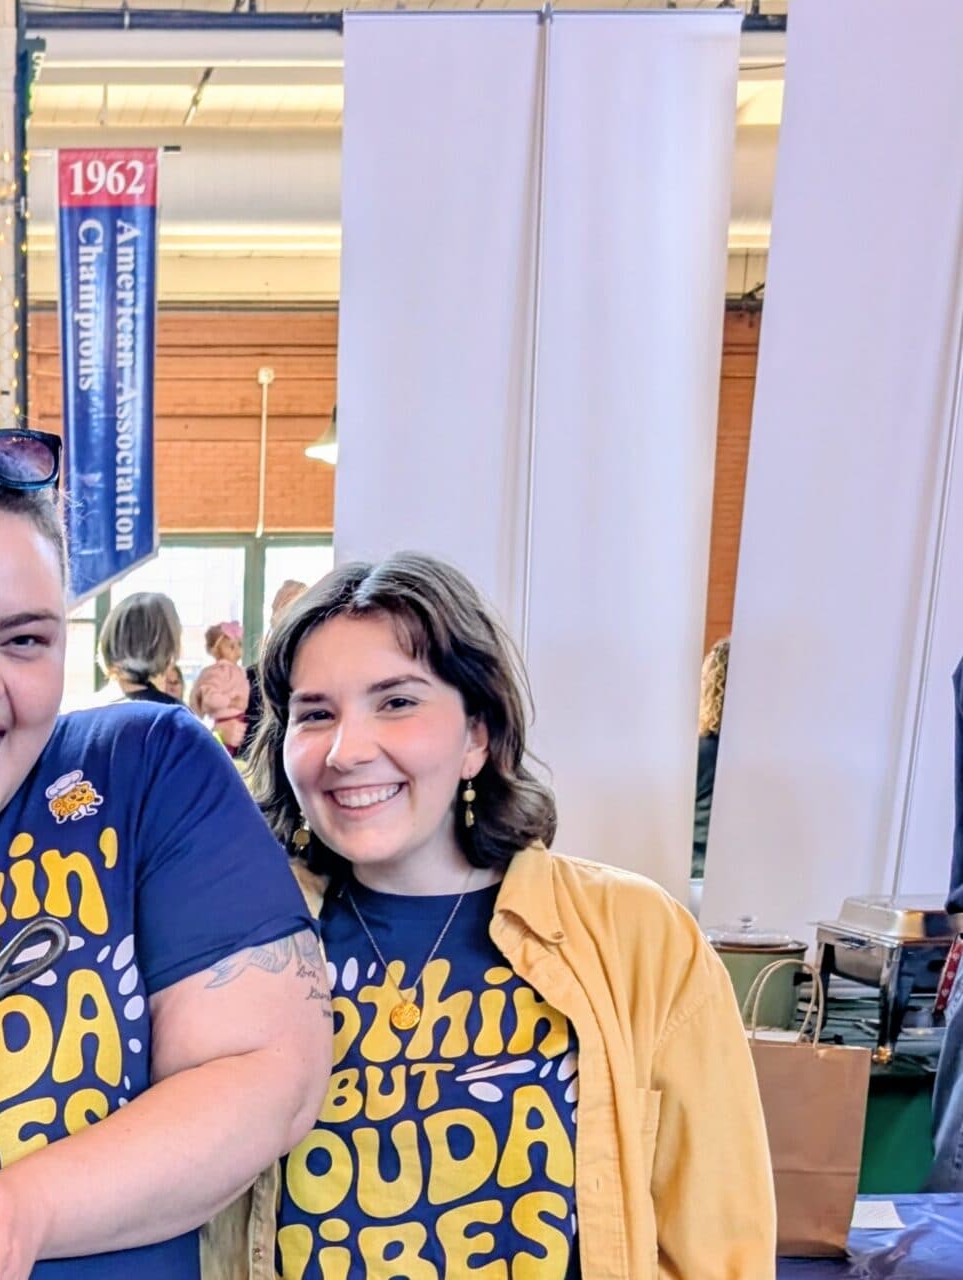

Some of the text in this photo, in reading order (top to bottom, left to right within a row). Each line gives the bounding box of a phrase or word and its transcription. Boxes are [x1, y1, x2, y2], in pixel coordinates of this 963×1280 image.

[69, 159, 146, 195] 1962
[73, 218, 104, 391] Champions
[115, 219, 142, 552] American Association
[332, 957, 570, 1068] othin
[286, 1085, 574, 1219] OUDA
[317, 1062, 456, 1124] BUT
